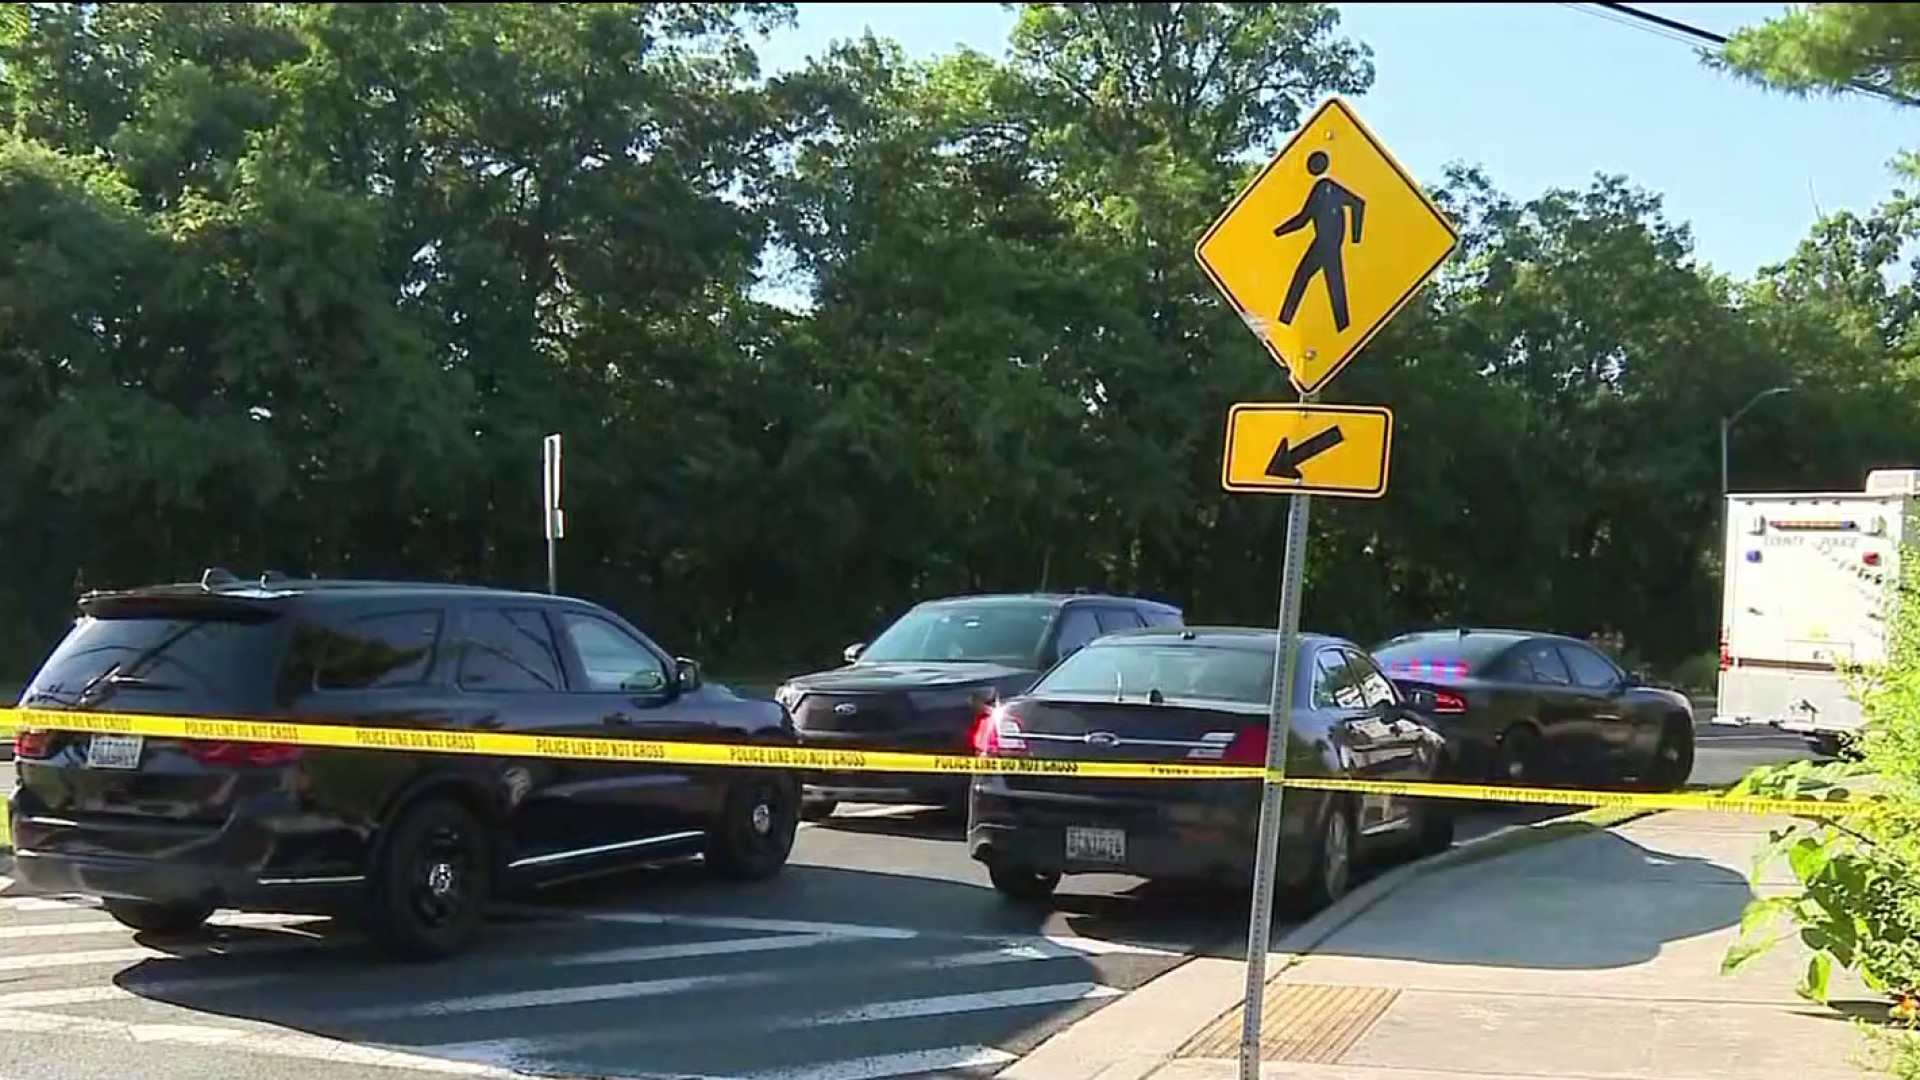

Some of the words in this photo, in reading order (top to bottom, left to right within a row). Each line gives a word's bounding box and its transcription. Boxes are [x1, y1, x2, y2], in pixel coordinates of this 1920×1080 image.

[356, 730, 387, 745] POLICE
[446, 735, 475, 750] CROSS
[536, 739, 570, 754] POLICE
[572, 741, 593, 755] LINE
[595, 742, 609, 755] DO
[611, 743, 630, 756] NOT
[632, 744, 664, 758] CROSS
[730, 748, 764, 763] POLICE
[768, 750, 790, 764] LINE
[792, 751, 807, 764] DO
[810, 752, 830, 765] NOT
[832, 753, 866, 767] CROSS
[934, 758, 971, 770] POLICE
[974, 759, 999, 771] LINE
[1001, 760, 1018, 771] DO
[1020, 761, 1040, 772] NOT
[1043, 761, 1078, 772] CROSS
